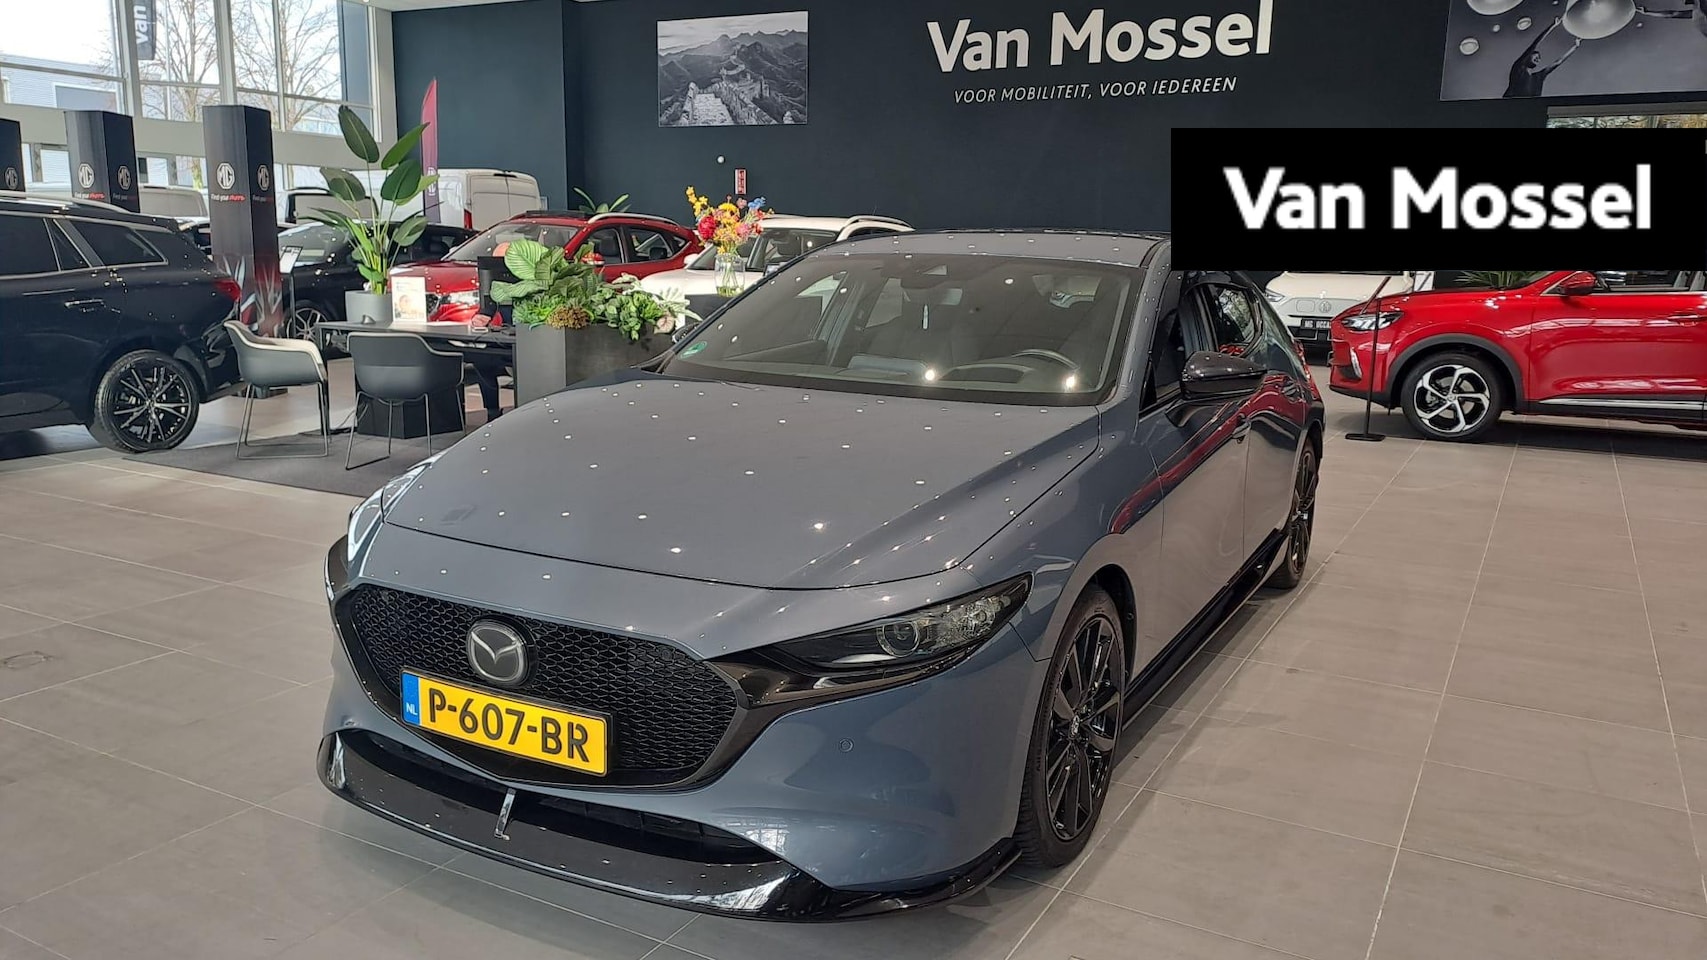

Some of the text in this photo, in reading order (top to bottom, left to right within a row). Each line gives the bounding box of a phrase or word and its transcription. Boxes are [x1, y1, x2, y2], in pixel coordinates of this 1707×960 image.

[926, 0, 1274, 73] Van Mossel
[954, 76, 1237, 104] VOOR MOBILITEIT, VOOR IEDEREEN
[217, 162, 235, 189] MG
[406, 702, 418, 716] NL
[429, 687, 590, 763] P-607-BR
